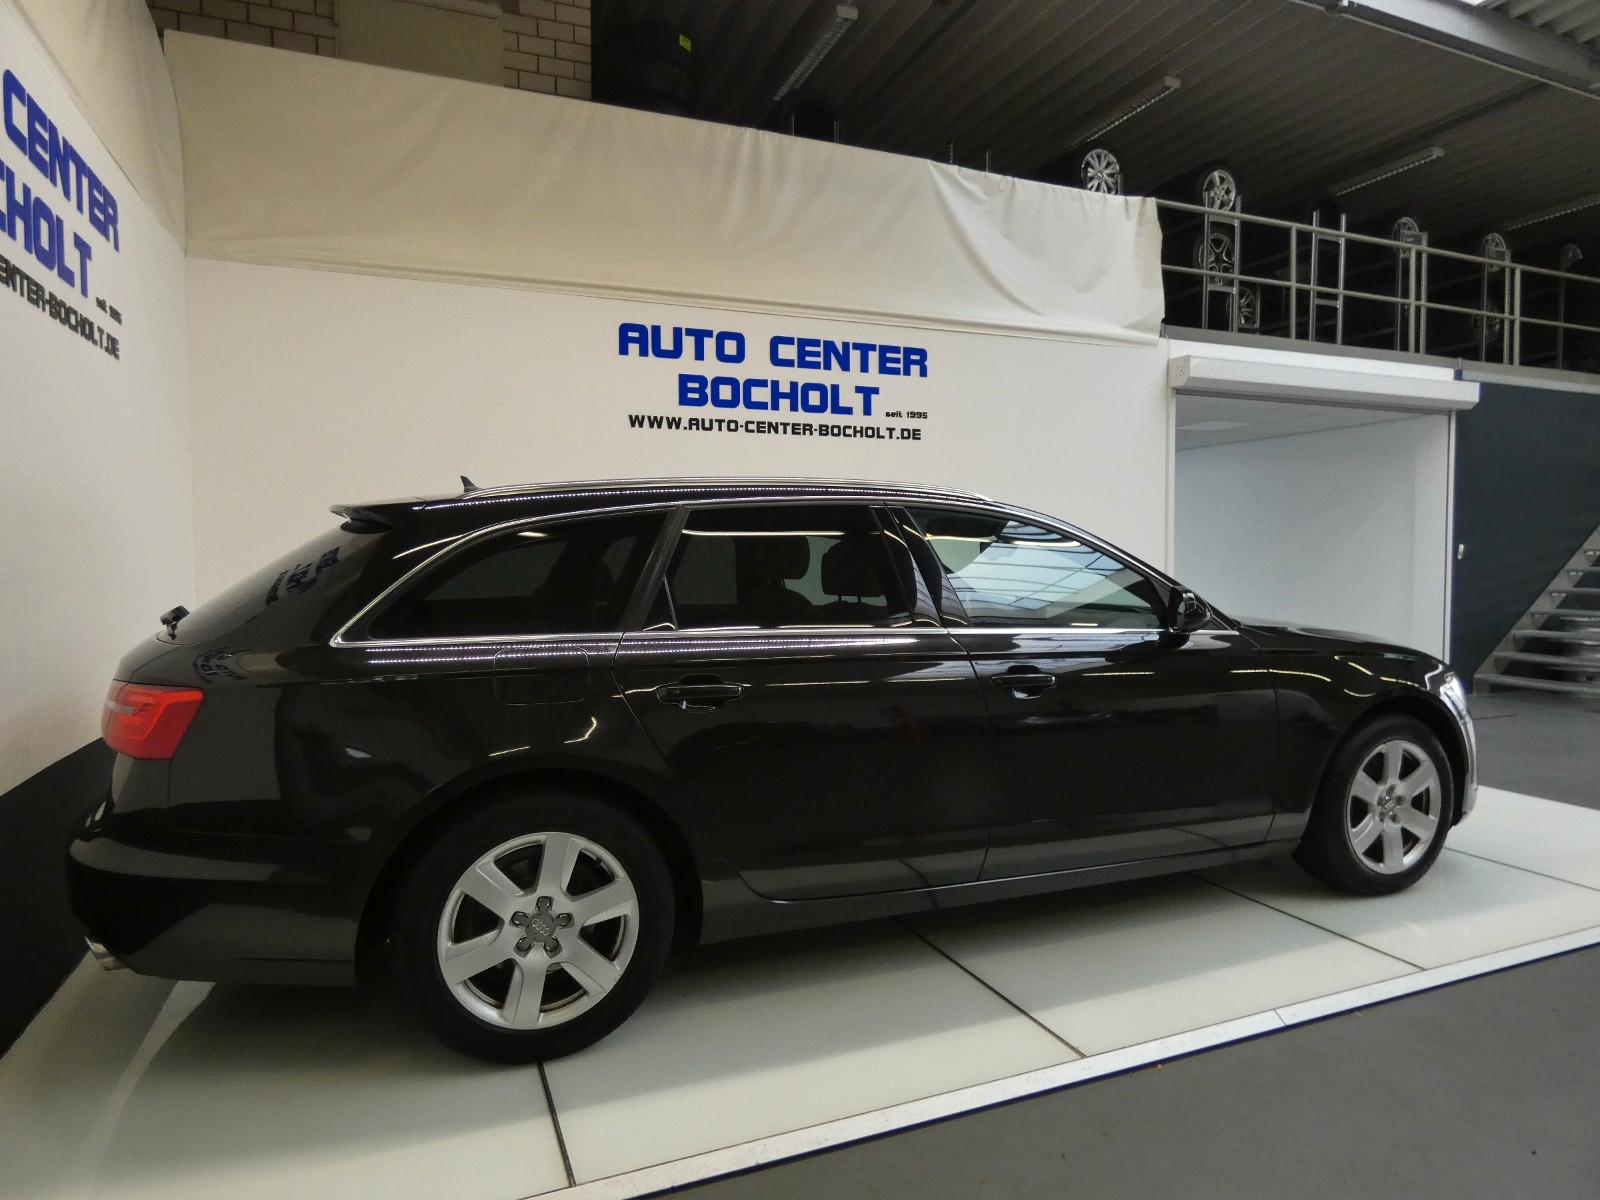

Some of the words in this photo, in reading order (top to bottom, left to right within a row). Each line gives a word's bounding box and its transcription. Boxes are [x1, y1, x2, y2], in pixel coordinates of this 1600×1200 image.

[3, 69, 120, 253] CENTER
[0, 157, 92, 298] HOLT
[618, 322, 746, 364] AUTO
[769, 335, 928, 378] CENTER
[678, 373, 880, 417] BOCHOLT
[885, 410, 903, 418] seit
[906, 411, 928, 419] 1995
[628, 414, 922, 441] WWW.AUTO-CENTER-BOCHOLT.DE
